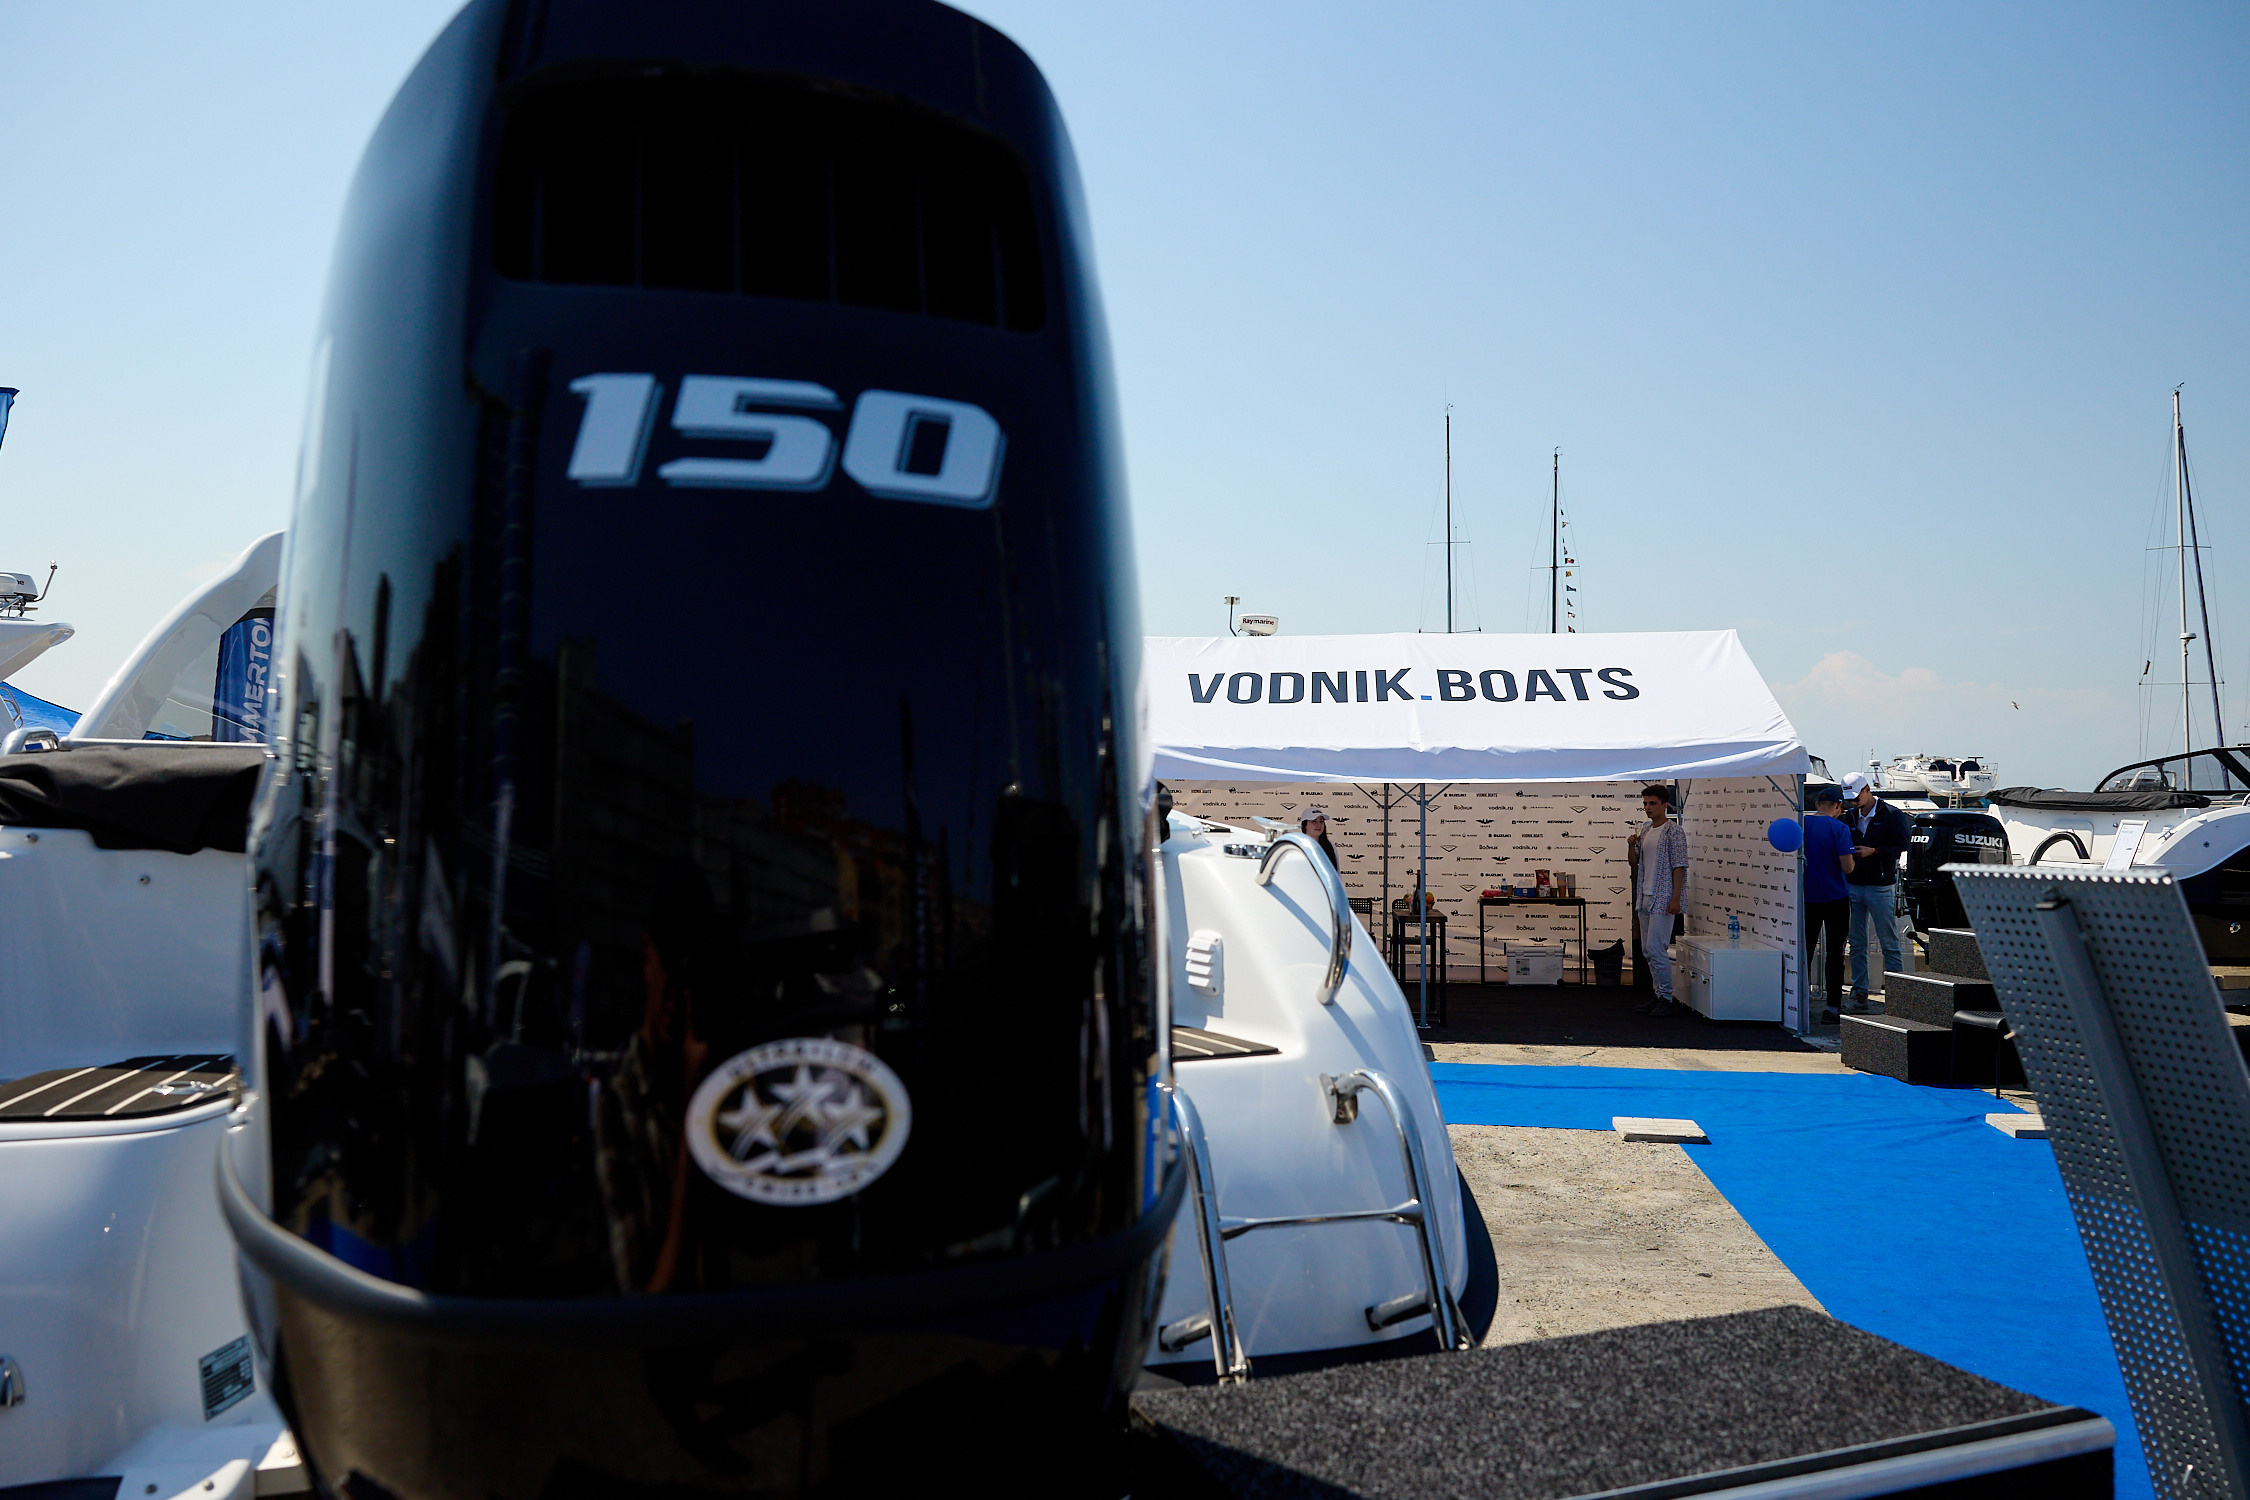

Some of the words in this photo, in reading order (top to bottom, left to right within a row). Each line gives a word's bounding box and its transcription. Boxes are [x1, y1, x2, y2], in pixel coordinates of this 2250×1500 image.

[567, 373, 1006, 509] 150
[1242, 618, 1275, 626] Raymarine
[1188, 666, 1640, 705] VODNIK.BOATS
[1910, 835, 1930, 843] 100
[1954, 833, 2003, 848] SUZUKI
